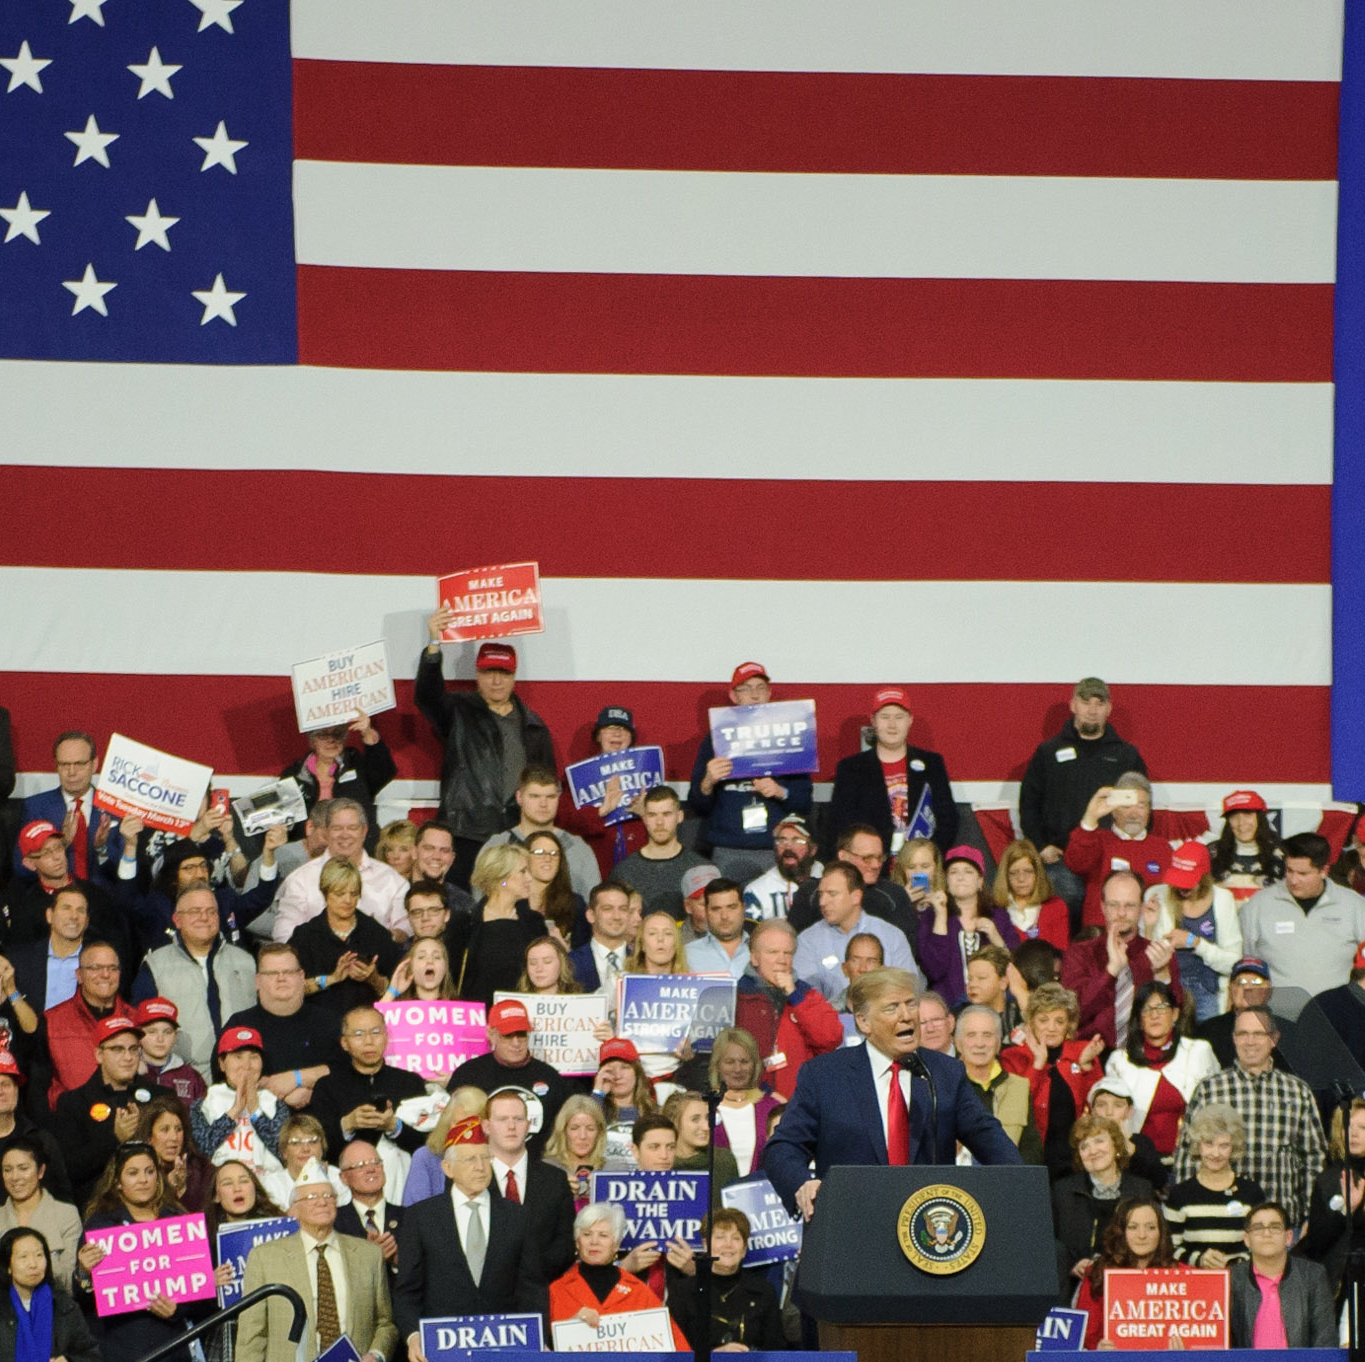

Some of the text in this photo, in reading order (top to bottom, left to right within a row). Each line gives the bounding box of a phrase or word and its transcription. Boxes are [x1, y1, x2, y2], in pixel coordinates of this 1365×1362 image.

[468, 576, 504, 590] MAKE
[442, 587, 537, 613] AMERICA
[448, 608, 533, 629] GREAT AGAIN
[328, 654, 354, 673] BUY
[302, 658, 386, 695] AMERICAN
[331, 683, 362, 702] HIRE
[305, 687, 389, 722] AMERICAN
[721, 721, 808, 741] TRUMP
[730, 736, 802, 752] PENCE
[112, 756, 142, 776] RICK
[600, 759, 635, 775] MAKE
[108, 769, 187, 807] SACCONE
[579, 771, 662, 803] AMRICA
[660, 987, 698, 999] MAKE
[384, 1006, 486, 1026] WOMEN
[537, 1003, 567, 1016] BUY
[624, 1001, 731, 1023] AMERICA
[533, 1017, 599, 1032] ERICAN
[624, 1022, 682, 1038] STRONG
[415, 1033, 454, 1046] FOR
[534, 1032, 568, 1047] HIRE
[534, 1048, 598, 1063] ERICAN
[608, 1180, 698, 1202] DRAIN
[636, 1203, 668, 1218] THE
[900, 1188, 940, 1228] PRESIDENT
[964, 1199, 983, 1236] UNITED
[90, 1220, 207, 1255] WOMEN
[622, 1218, 702, 1240] WAMP
[130, 1254, 171, 1275] FOR
[912, 1254, 934, 1270] SEAL
[949, 1242, 979, 1270] STATES
[102, 1272, 207, 1308] TRUMP
[1146, 1283, 1187, 1295] MAKE
[1109, 1300, 1224, 1321] AMERICA
[436, 1324, 528, 1350] DRAIN
[597, 1322, 627, 1339] BUY
[1116, 1323, 1217, 1338] GREAT AGAIN
